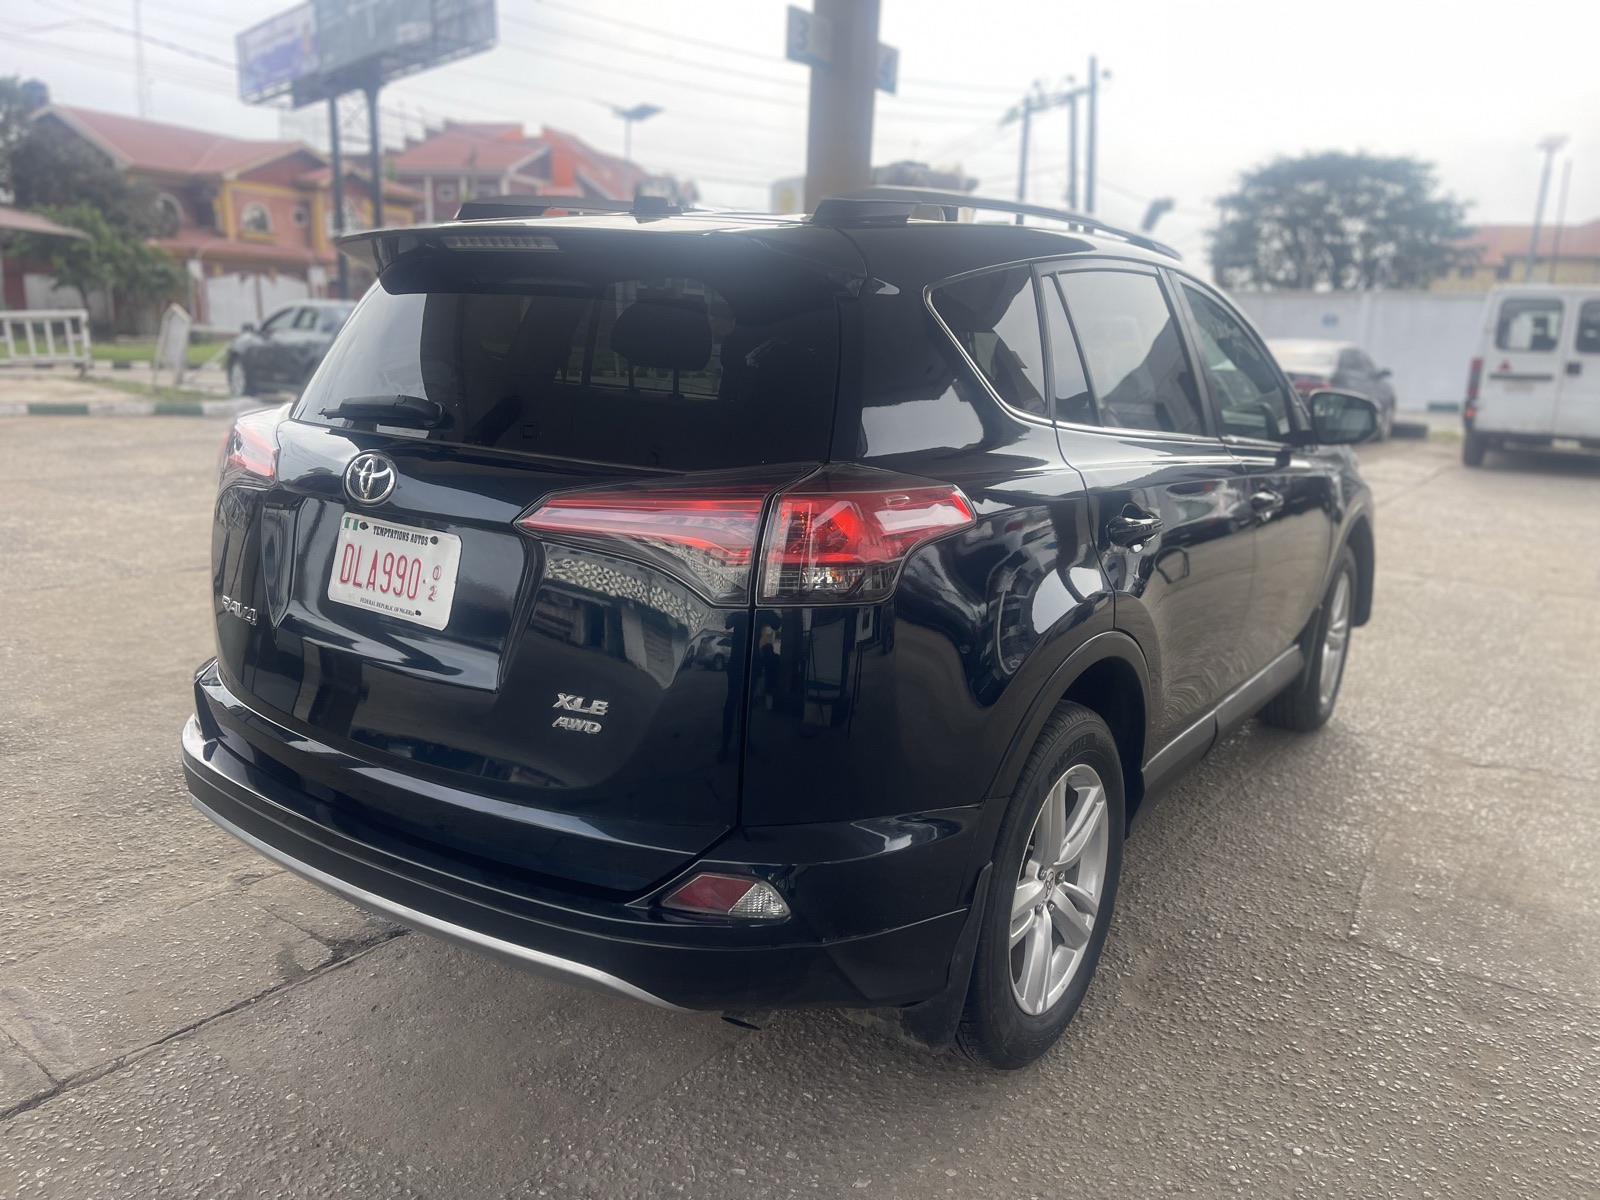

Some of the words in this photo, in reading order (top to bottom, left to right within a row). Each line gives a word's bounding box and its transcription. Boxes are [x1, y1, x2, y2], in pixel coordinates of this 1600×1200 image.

[373, 525, 410, 542] TEMPTATIONS
[410, 533, 429, 546] AUTOS
[340, 543, 422, 600] DLA990
[359, 597, 376, 607] FEDERAL
[376, 601, 394, 612] REPUBLIC
[399, 607, 415, 617] NIGERIA
[552, 692, 609, 716] XLE
[551, 716, 603, 735] AWD
